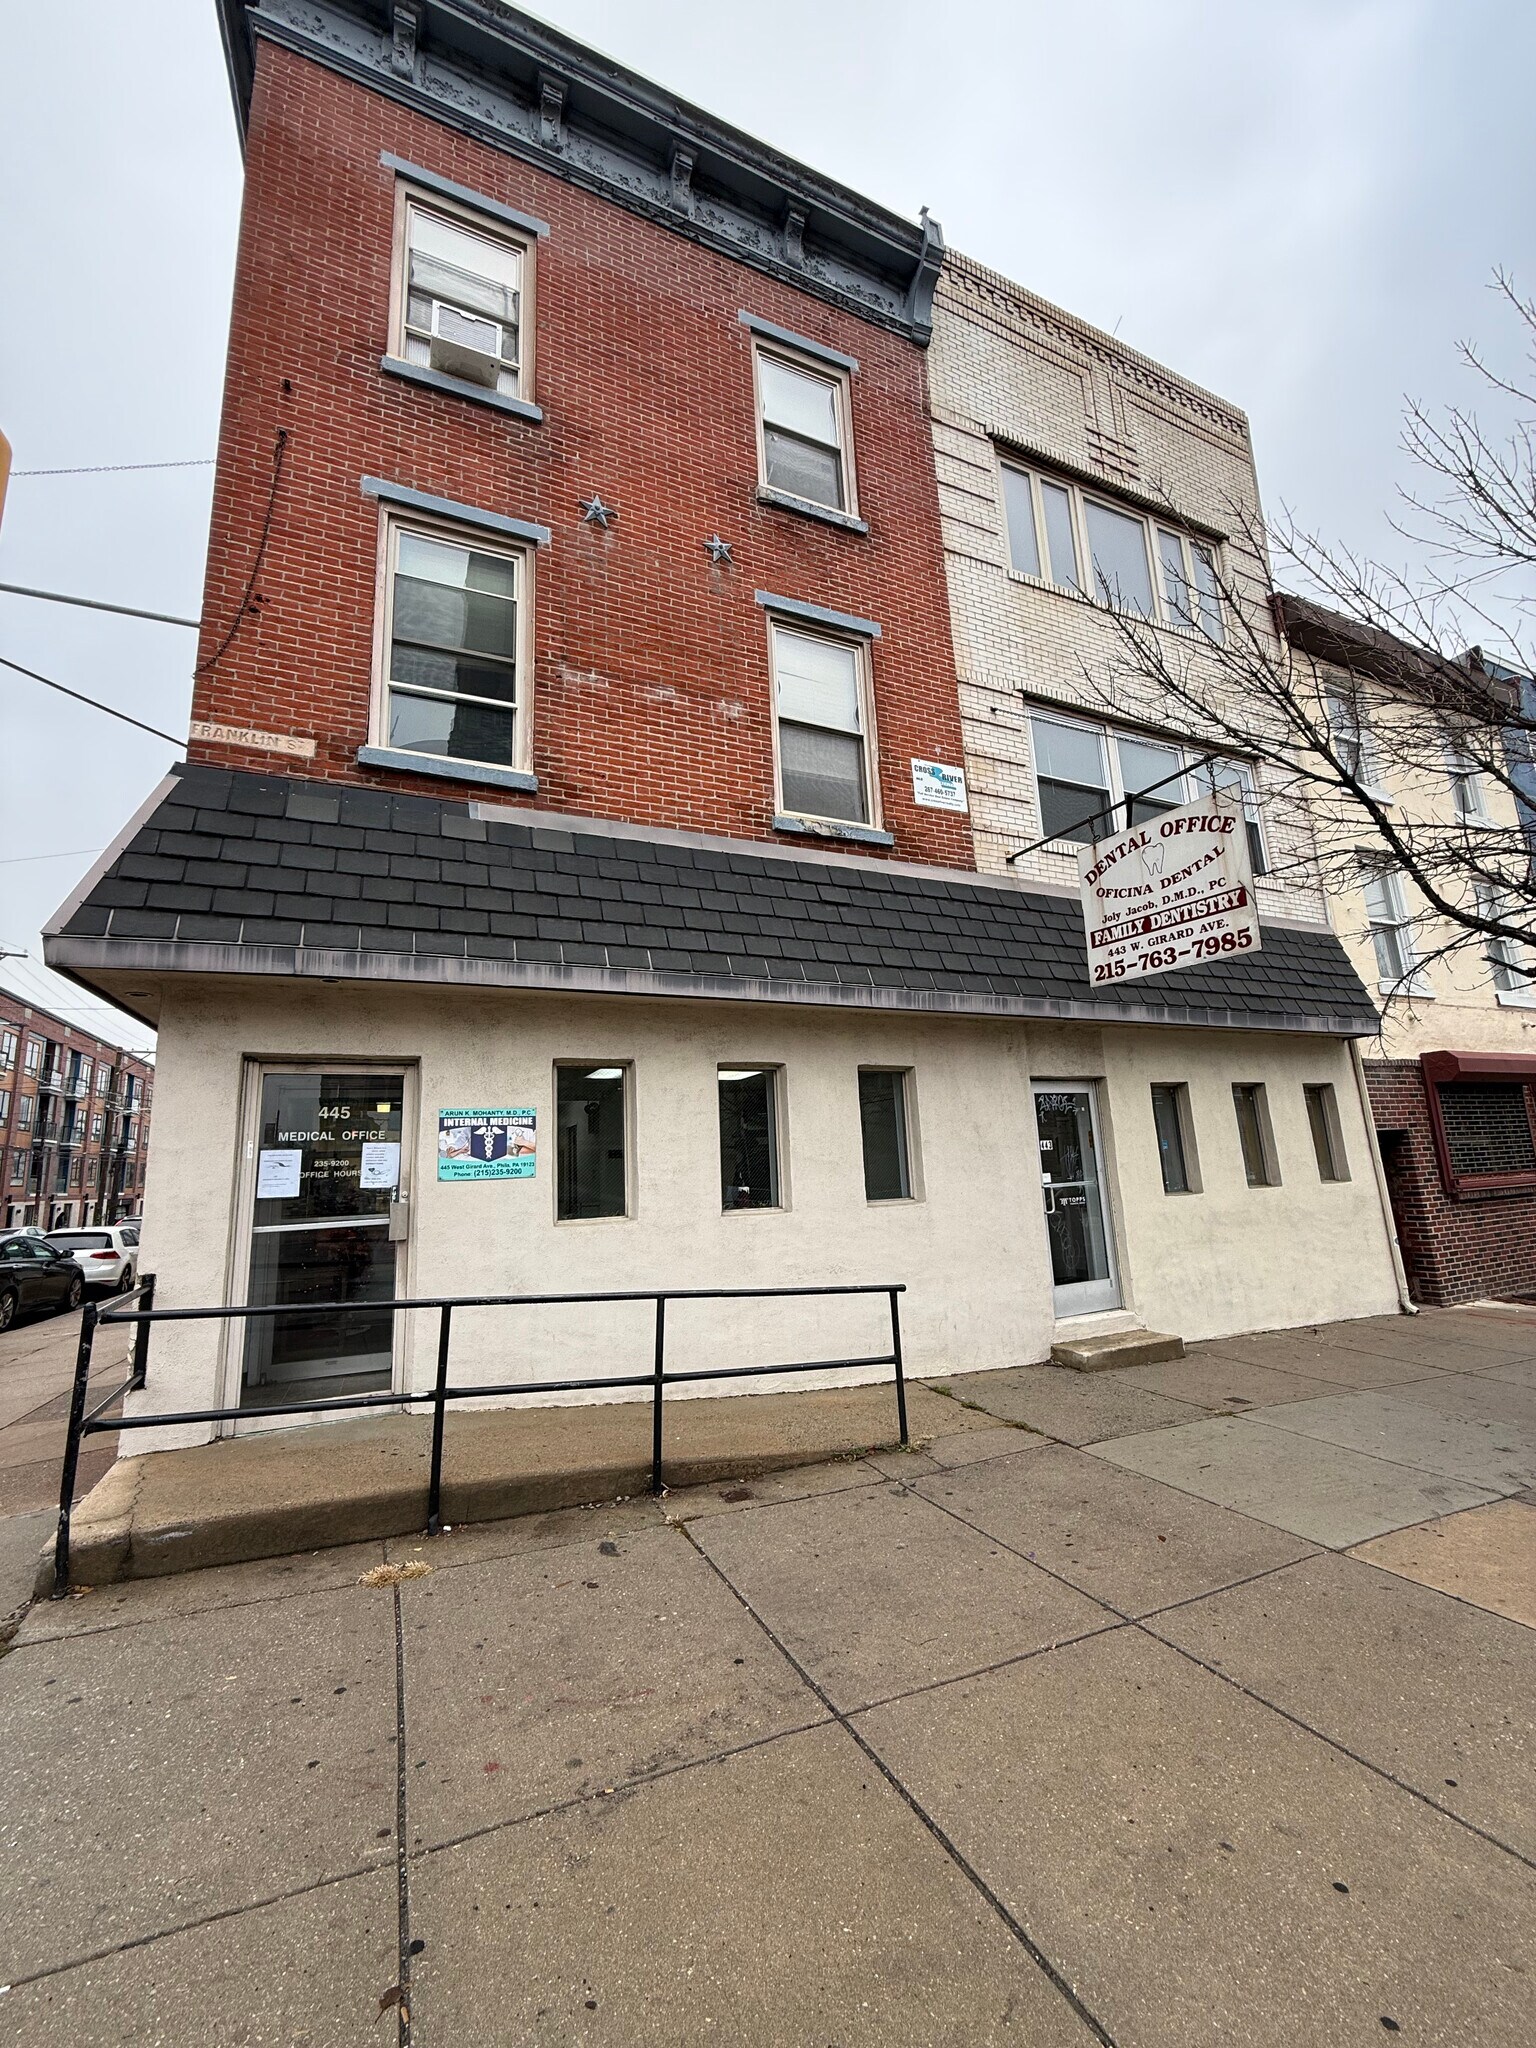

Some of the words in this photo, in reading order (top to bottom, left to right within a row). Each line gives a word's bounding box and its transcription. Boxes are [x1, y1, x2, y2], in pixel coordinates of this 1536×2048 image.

[191, 723, 279, 747] FRANKLIN
[914, 764, 936, 776] CROSS
[941, 774, 963, 784] RIVER
[1084, 830, 1152, 887] DENTAL
[1160, 815, 1236, 838] OFFICE
[1096, 884, 1154, 899] OFICINA
[1159, 846, 1225, 890] DENTAL
[1101, 911, 1122, 924] Joly
[1125, 901, 1159, 917] Jacob,
[1208, 877, 1227, 891] PC
[1093, 919, 1146, 946] FAMILY
[1149, 889, 1243, 930] DENTISTRY
[1107, 946, 1127, 958] 443
[1130, 941, 1144, 952] W.
[1147, 926, 1195, 947] GIRARD
[1198, 918, 1230, 934] AVE.
[1093, 926, 1253, 982] 215-763-7985
[318, 1106, 350, 1120] 445
[444, 1117, 489, 1127] INTERNAL
[490, 1117, 533, 1126] MEDICINE
[278, 1131, 336, 1142] MEDICAL
[342, 1130, 386, 1141] OFFICE
[299, 1170, 330, 1179] OFFICE
[333, 1170, 362, 1178] HOURS
[313, 1159, 350, 1168] 235-9200
[473, 1167, 523, 1178] (215)235-9200
